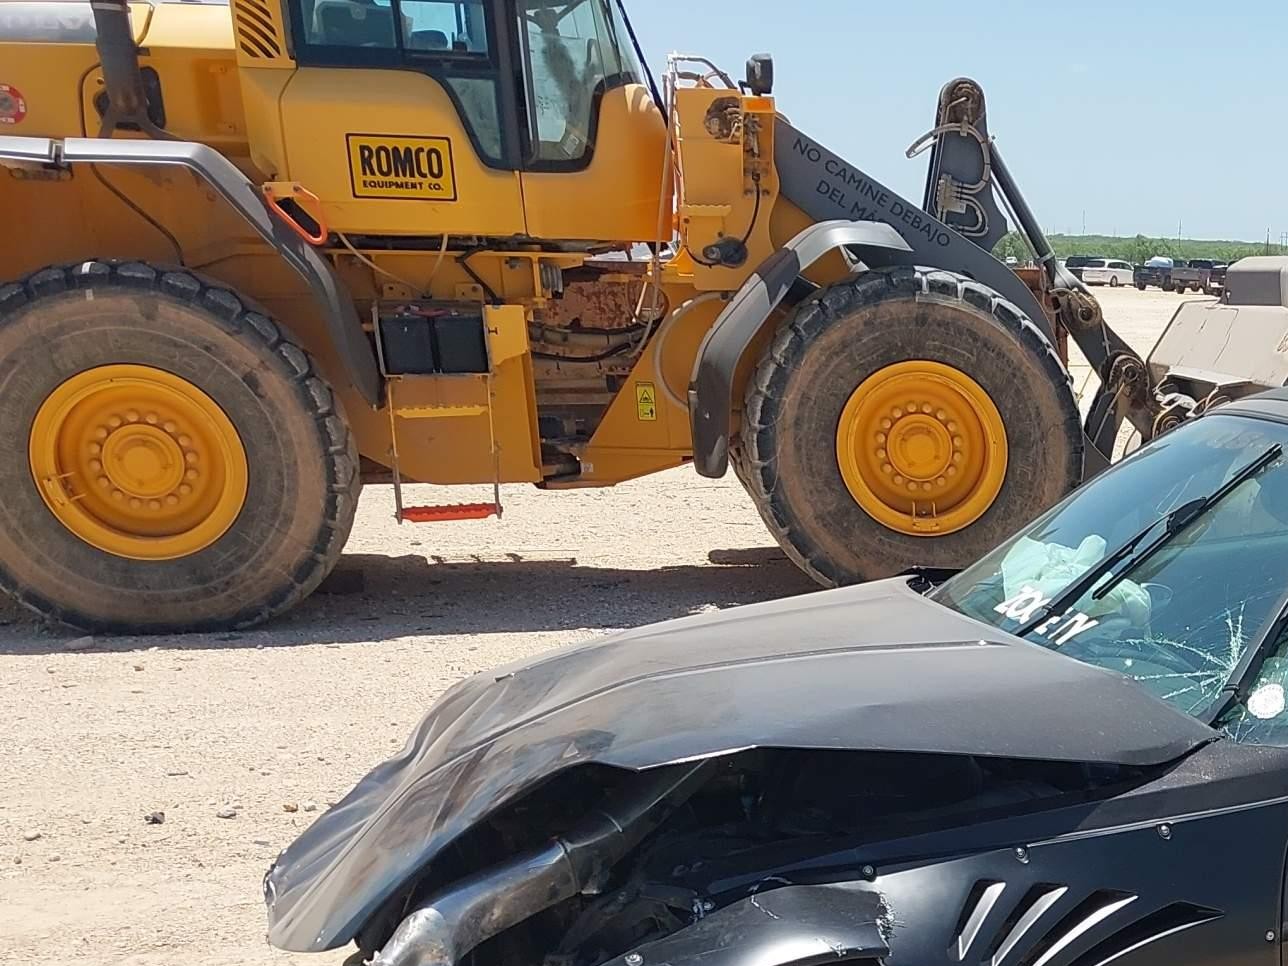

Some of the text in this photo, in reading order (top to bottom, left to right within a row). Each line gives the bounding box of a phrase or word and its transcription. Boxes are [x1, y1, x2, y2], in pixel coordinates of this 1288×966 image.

[359, 144, 443, 179] ROMCO
[363, 180, 444, 191] EQUIPMENT CO.
[793, 138, 821, 162] NO
[825, 160, 888, 208] CAMINE
[890, 202, 950, 247] DEBAJO
[816, 180, 846, 209] DEL
